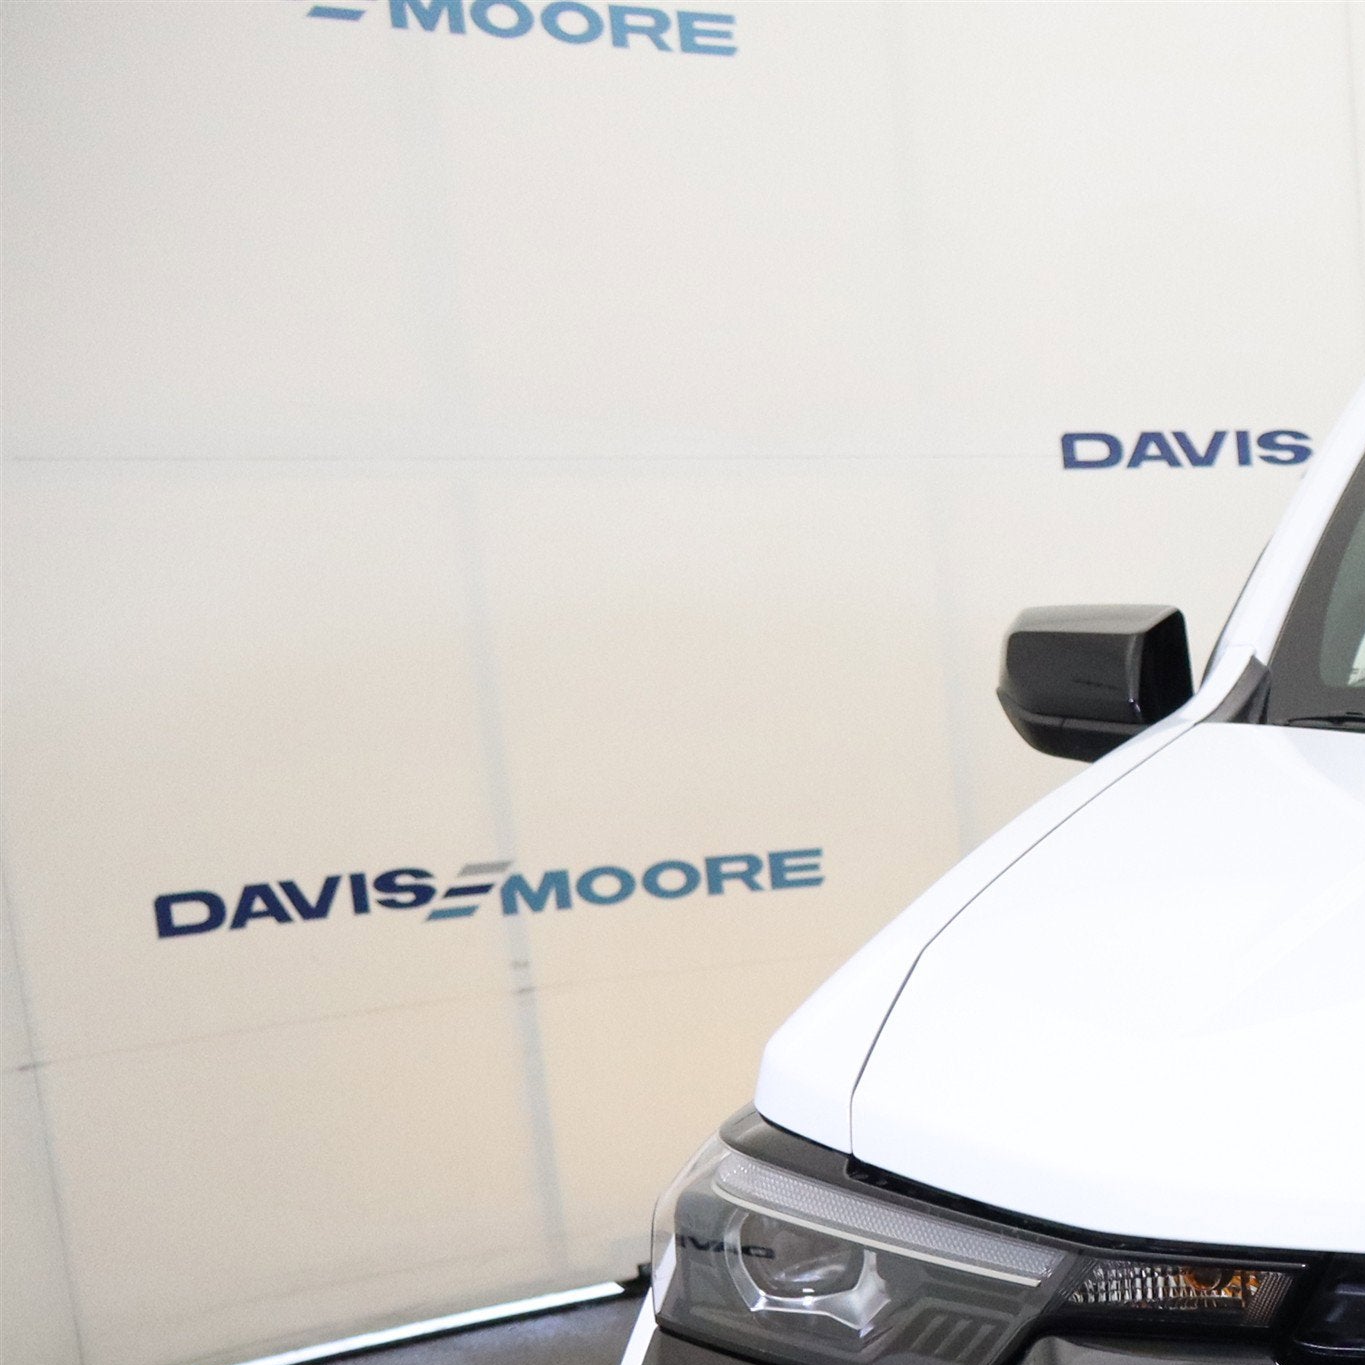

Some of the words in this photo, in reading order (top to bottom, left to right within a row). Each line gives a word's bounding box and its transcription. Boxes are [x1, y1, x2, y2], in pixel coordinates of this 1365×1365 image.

[387, 0, 738, 56] MOORE
[1061, 430, 1313, 469] DAVIS
[154, 867, 438, 939] DAVIS
[500, 848, 826, 916] MOORE
